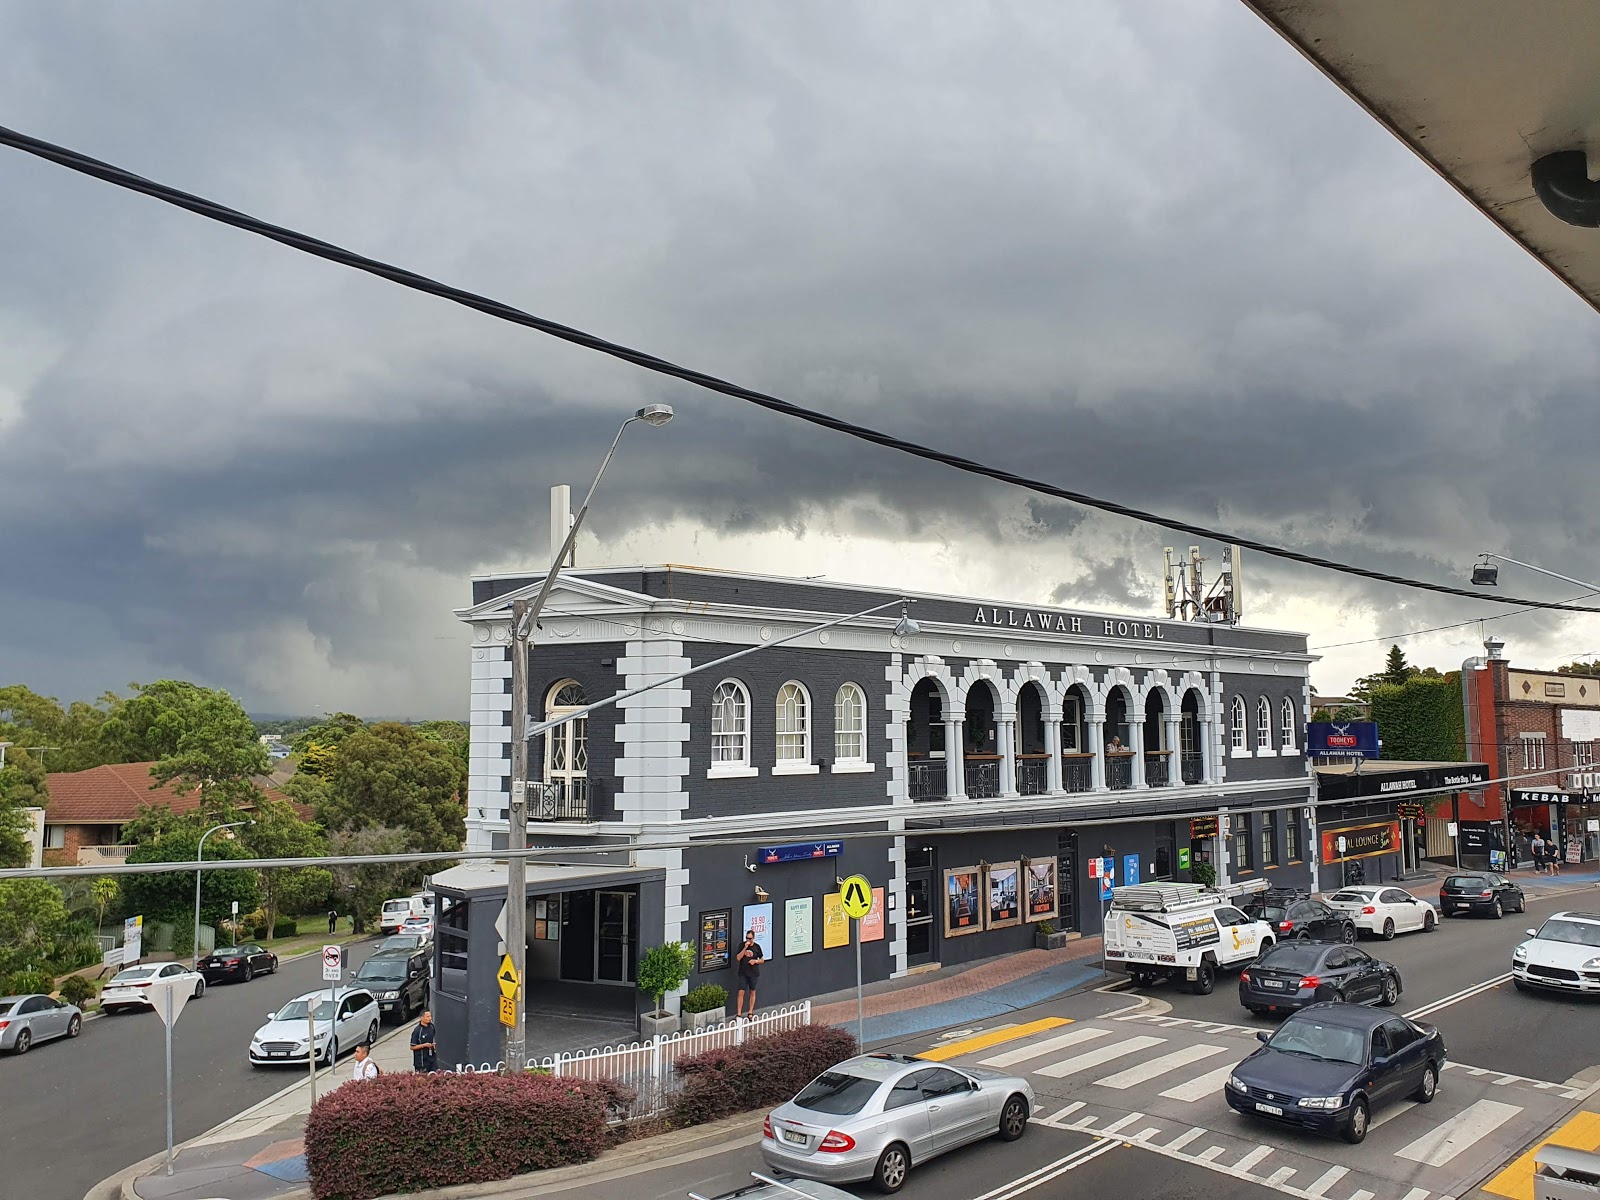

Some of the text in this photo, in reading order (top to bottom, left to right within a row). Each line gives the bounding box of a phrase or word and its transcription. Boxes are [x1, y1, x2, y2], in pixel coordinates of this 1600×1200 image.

[974, 606, 1164, 639] ALLAWAH HOTEL
[1329, 736, 1354, 744] TOOHEYS
[1380, 779, 1417, 792] ALLAWAH HOTEL
[1521, 792, 1570, 803] KEBAB
[1355, 834, 1379, 848] LOUNGE
[751, 915, 766, 925] $9.90
[750, 924, 767, 933] PIZZA
[503, 999, 513, 1016] 25
